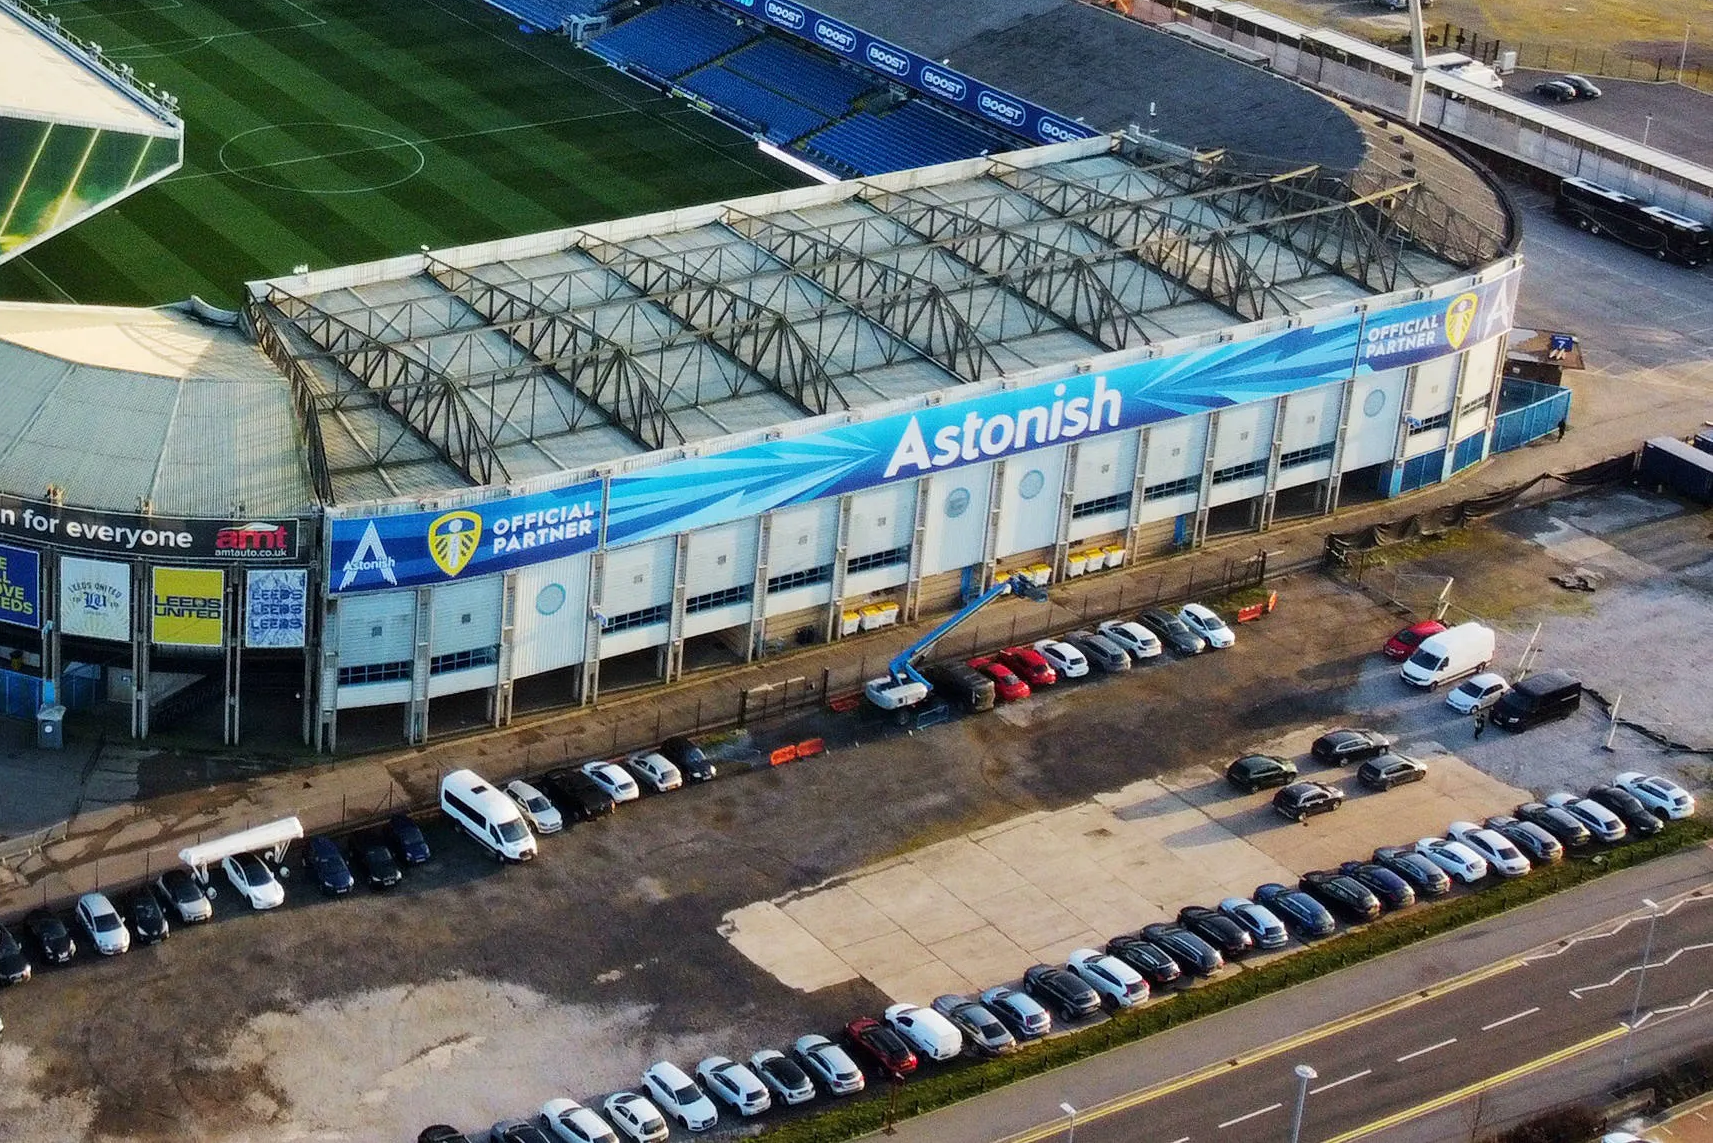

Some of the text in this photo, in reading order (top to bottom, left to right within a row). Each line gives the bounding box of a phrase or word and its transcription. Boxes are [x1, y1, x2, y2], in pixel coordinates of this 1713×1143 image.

[768, 3, 802, 23] BOOST
[818, 24, 853, 46] BOOST
[870, 46, 906, 69] BOOST
[924, 71, 963, 94] BOOST
[981, 96, 1022, 119] BOOST
[1368, 314, 1438, 342] OFFICIAL
[1366, 331, 1436, 358] PARTNER
[883, 376, 1122, 478] Astonish
[22, 508, 60, 534] for
[66, 521, 193, 549] everyone
[492, 501, 595, 536] OFFICIAL
[216, 525, 288, 550] amt
[493, 519, 592, 555] PARTNER
[214, 548, 288, 557] amtauto.co.uk
[343, 556, 396, 573] Astonish
[154, 595, 222, 608] LEEDS
[251, 589, 303, 601] LEEDS
[155, 608, 221, 619] UNITED
[251, 603, 303, 615] LEEDS
[251, 618, 303, 630] LEEDS
